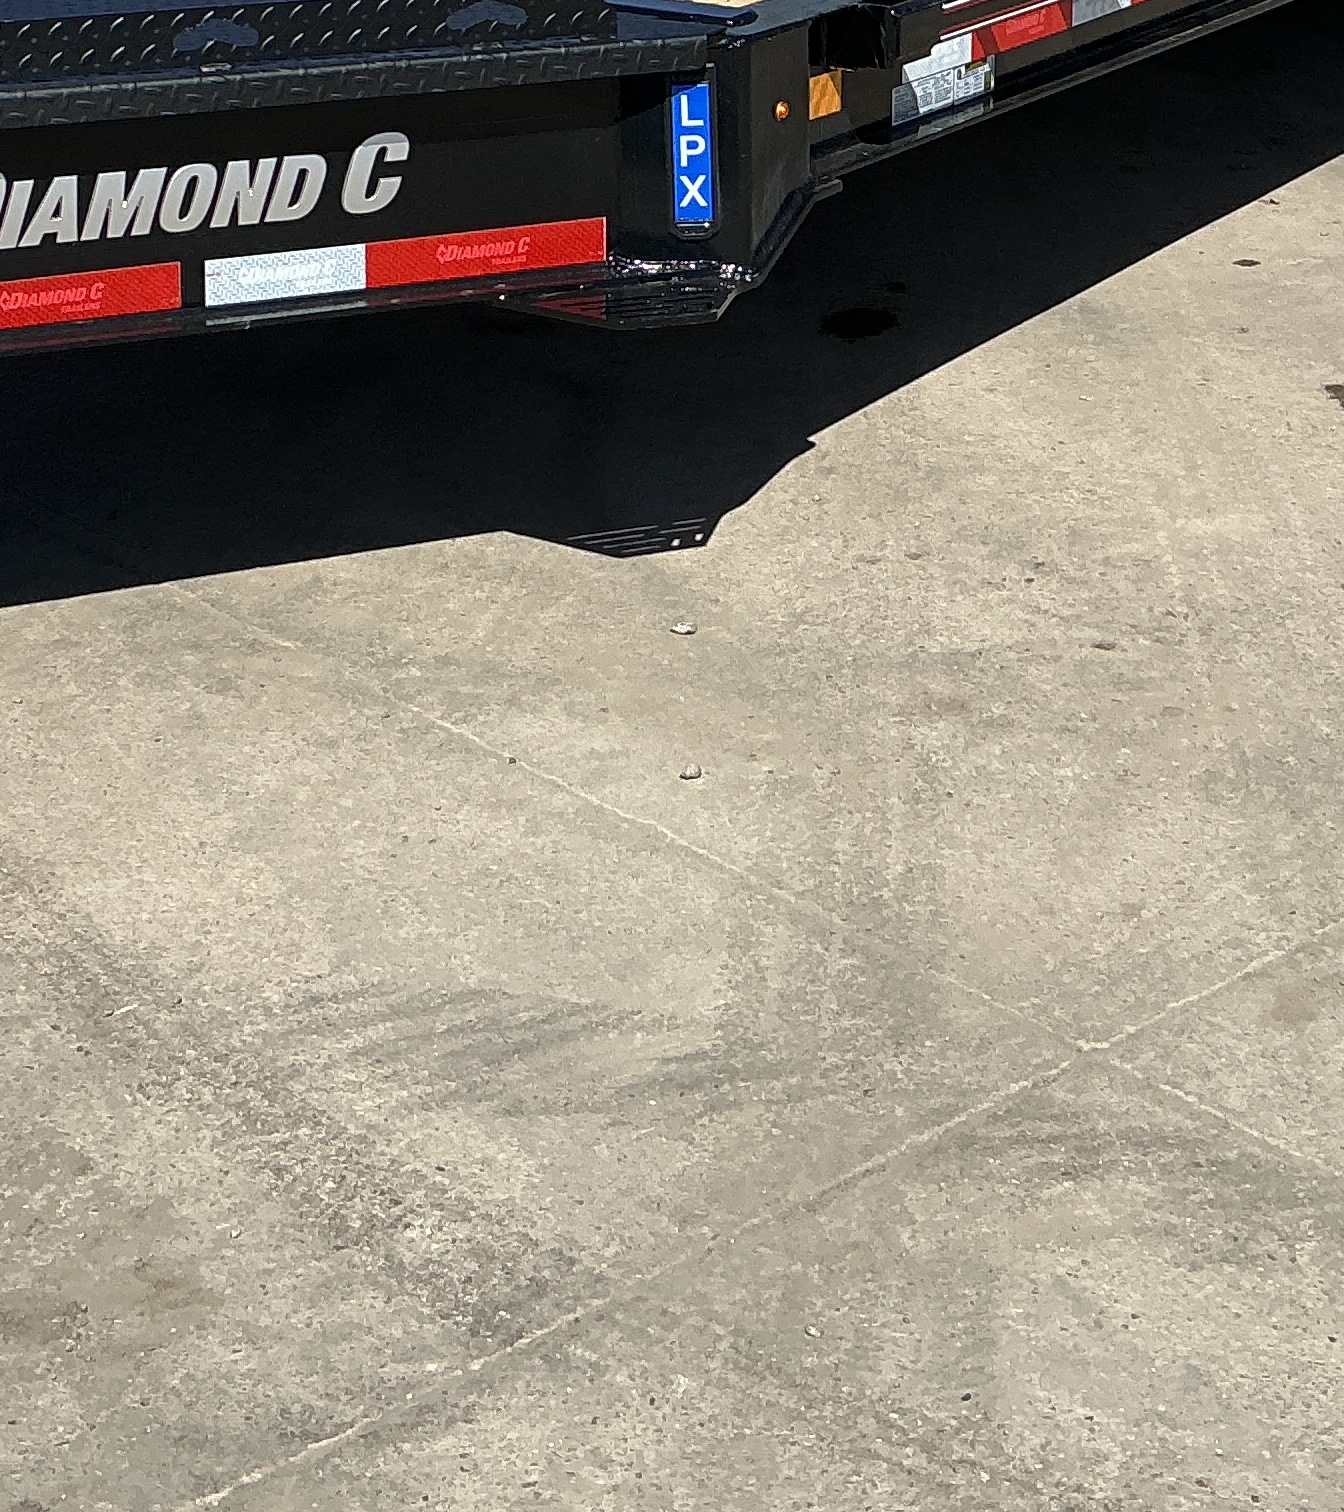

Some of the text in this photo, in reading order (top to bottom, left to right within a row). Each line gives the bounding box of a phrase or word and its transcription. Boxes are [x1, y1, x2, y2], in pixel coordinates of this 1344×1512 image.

[340, 131, 410, 215] C
[678, 93, 709, 208] LPX
[443, 236, 531, 263] DIAMOND C
[9, 281, 105, 310] DIAMOND C
